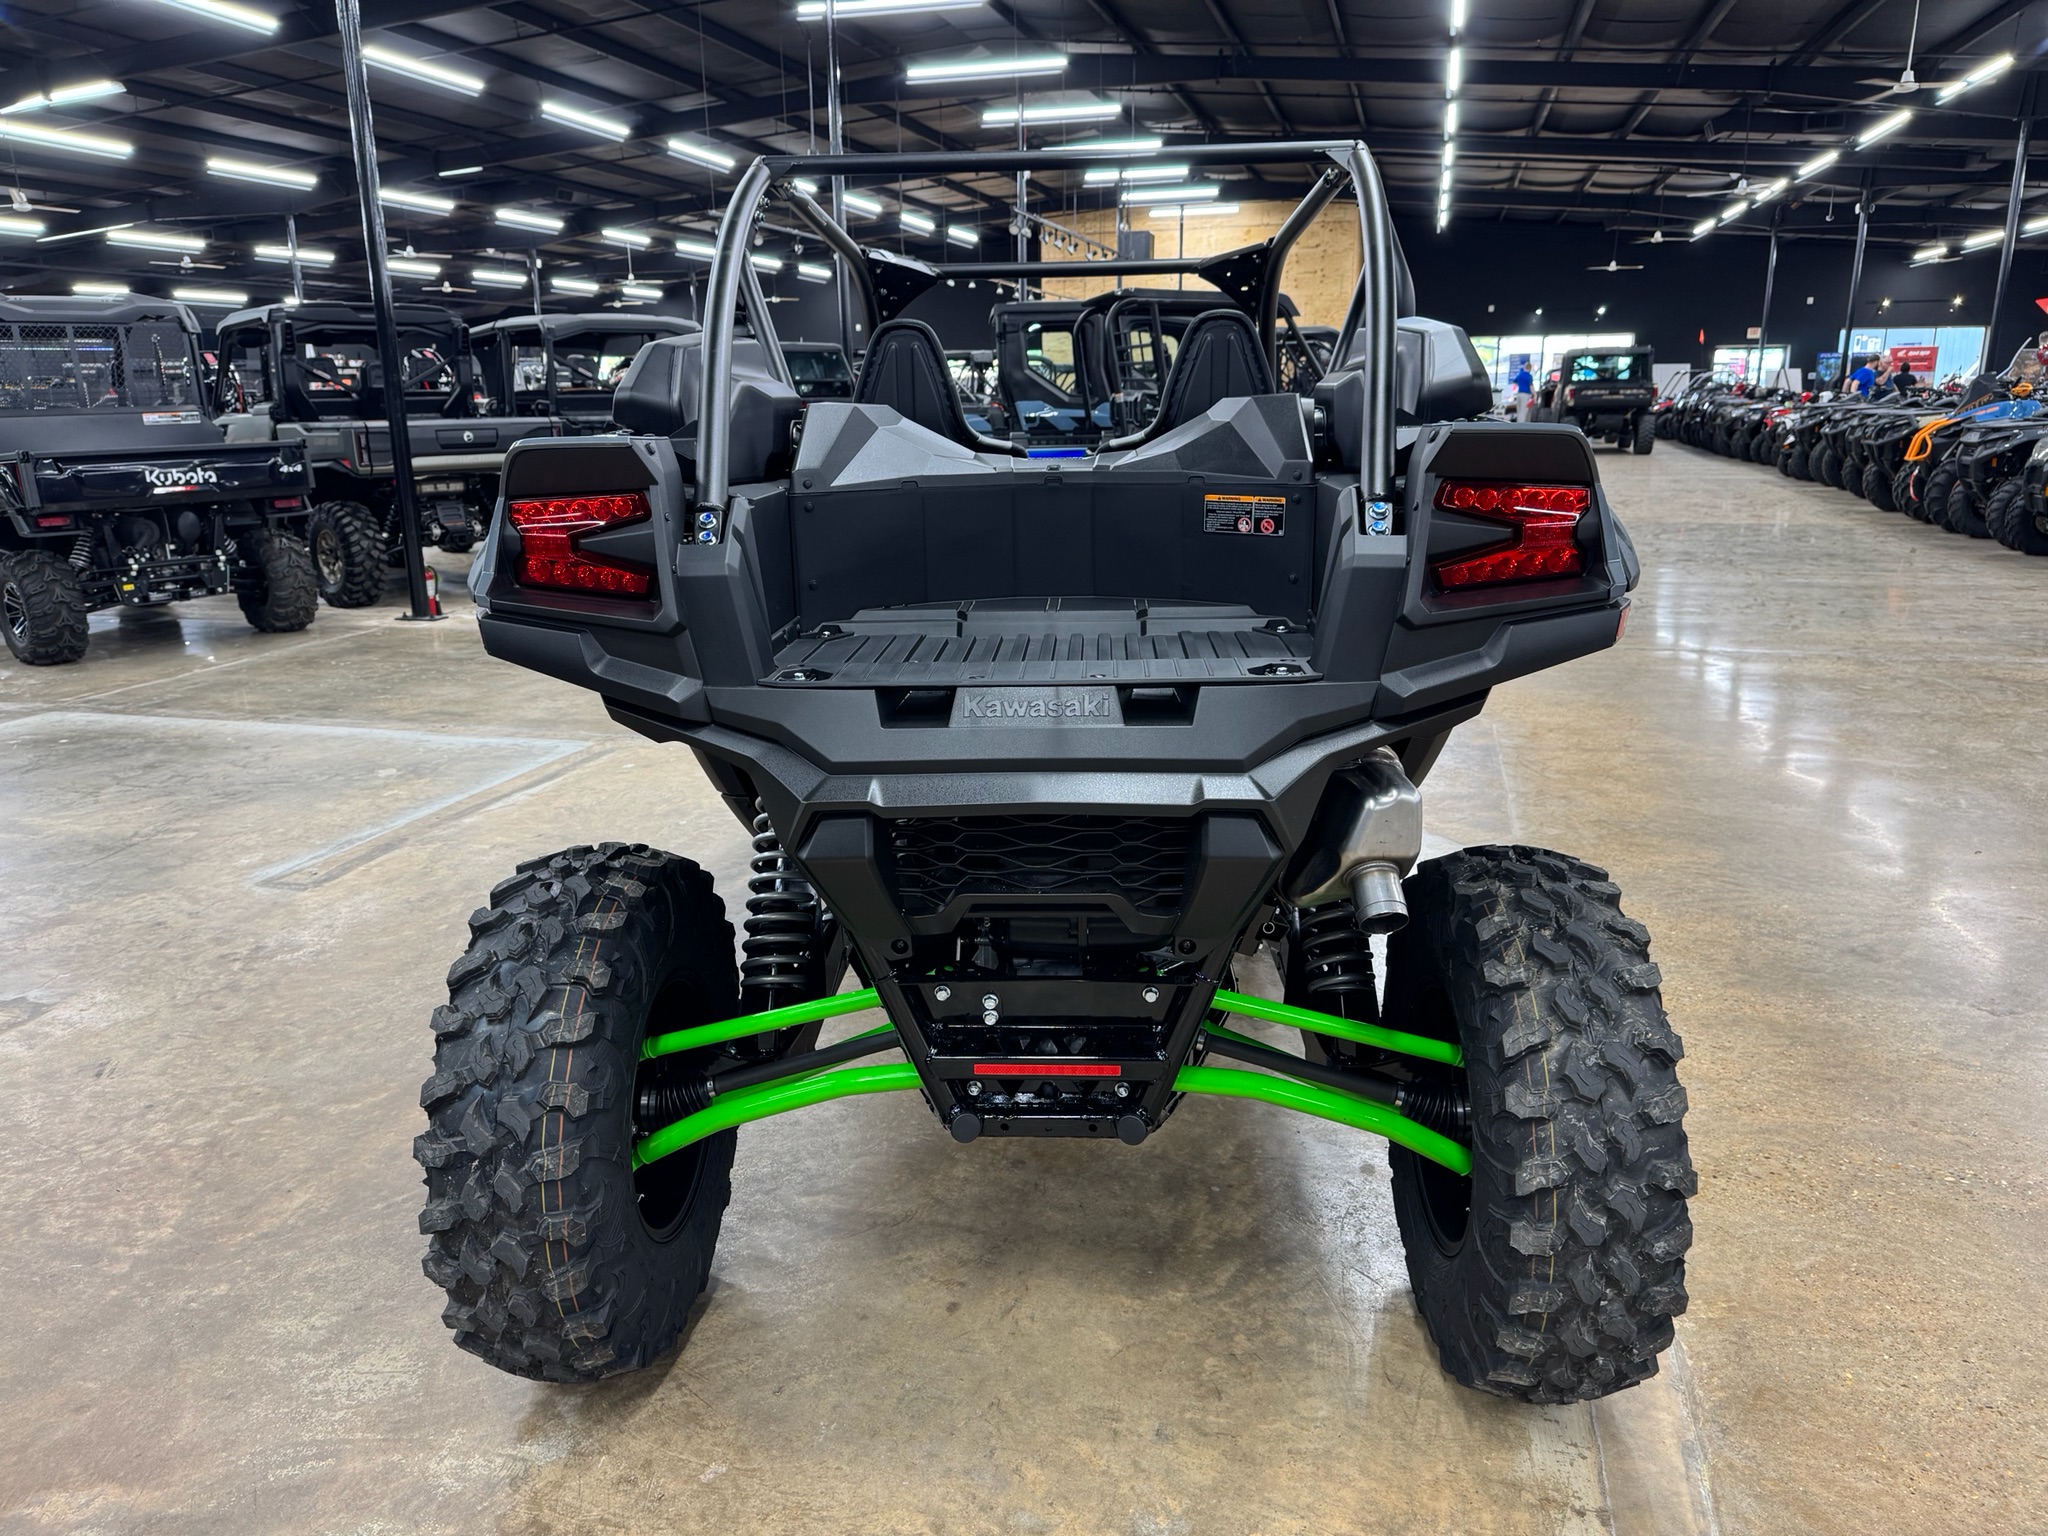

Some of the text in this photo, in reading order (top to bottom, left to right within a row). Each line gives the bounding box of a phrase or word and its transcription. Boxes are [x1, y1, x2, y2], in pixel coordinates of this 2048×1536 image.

[145, 467, 218, 486] Kubota
[279, 464, 303, 473] 4x4
[963, 694, 1111, 718] Kawasaki
